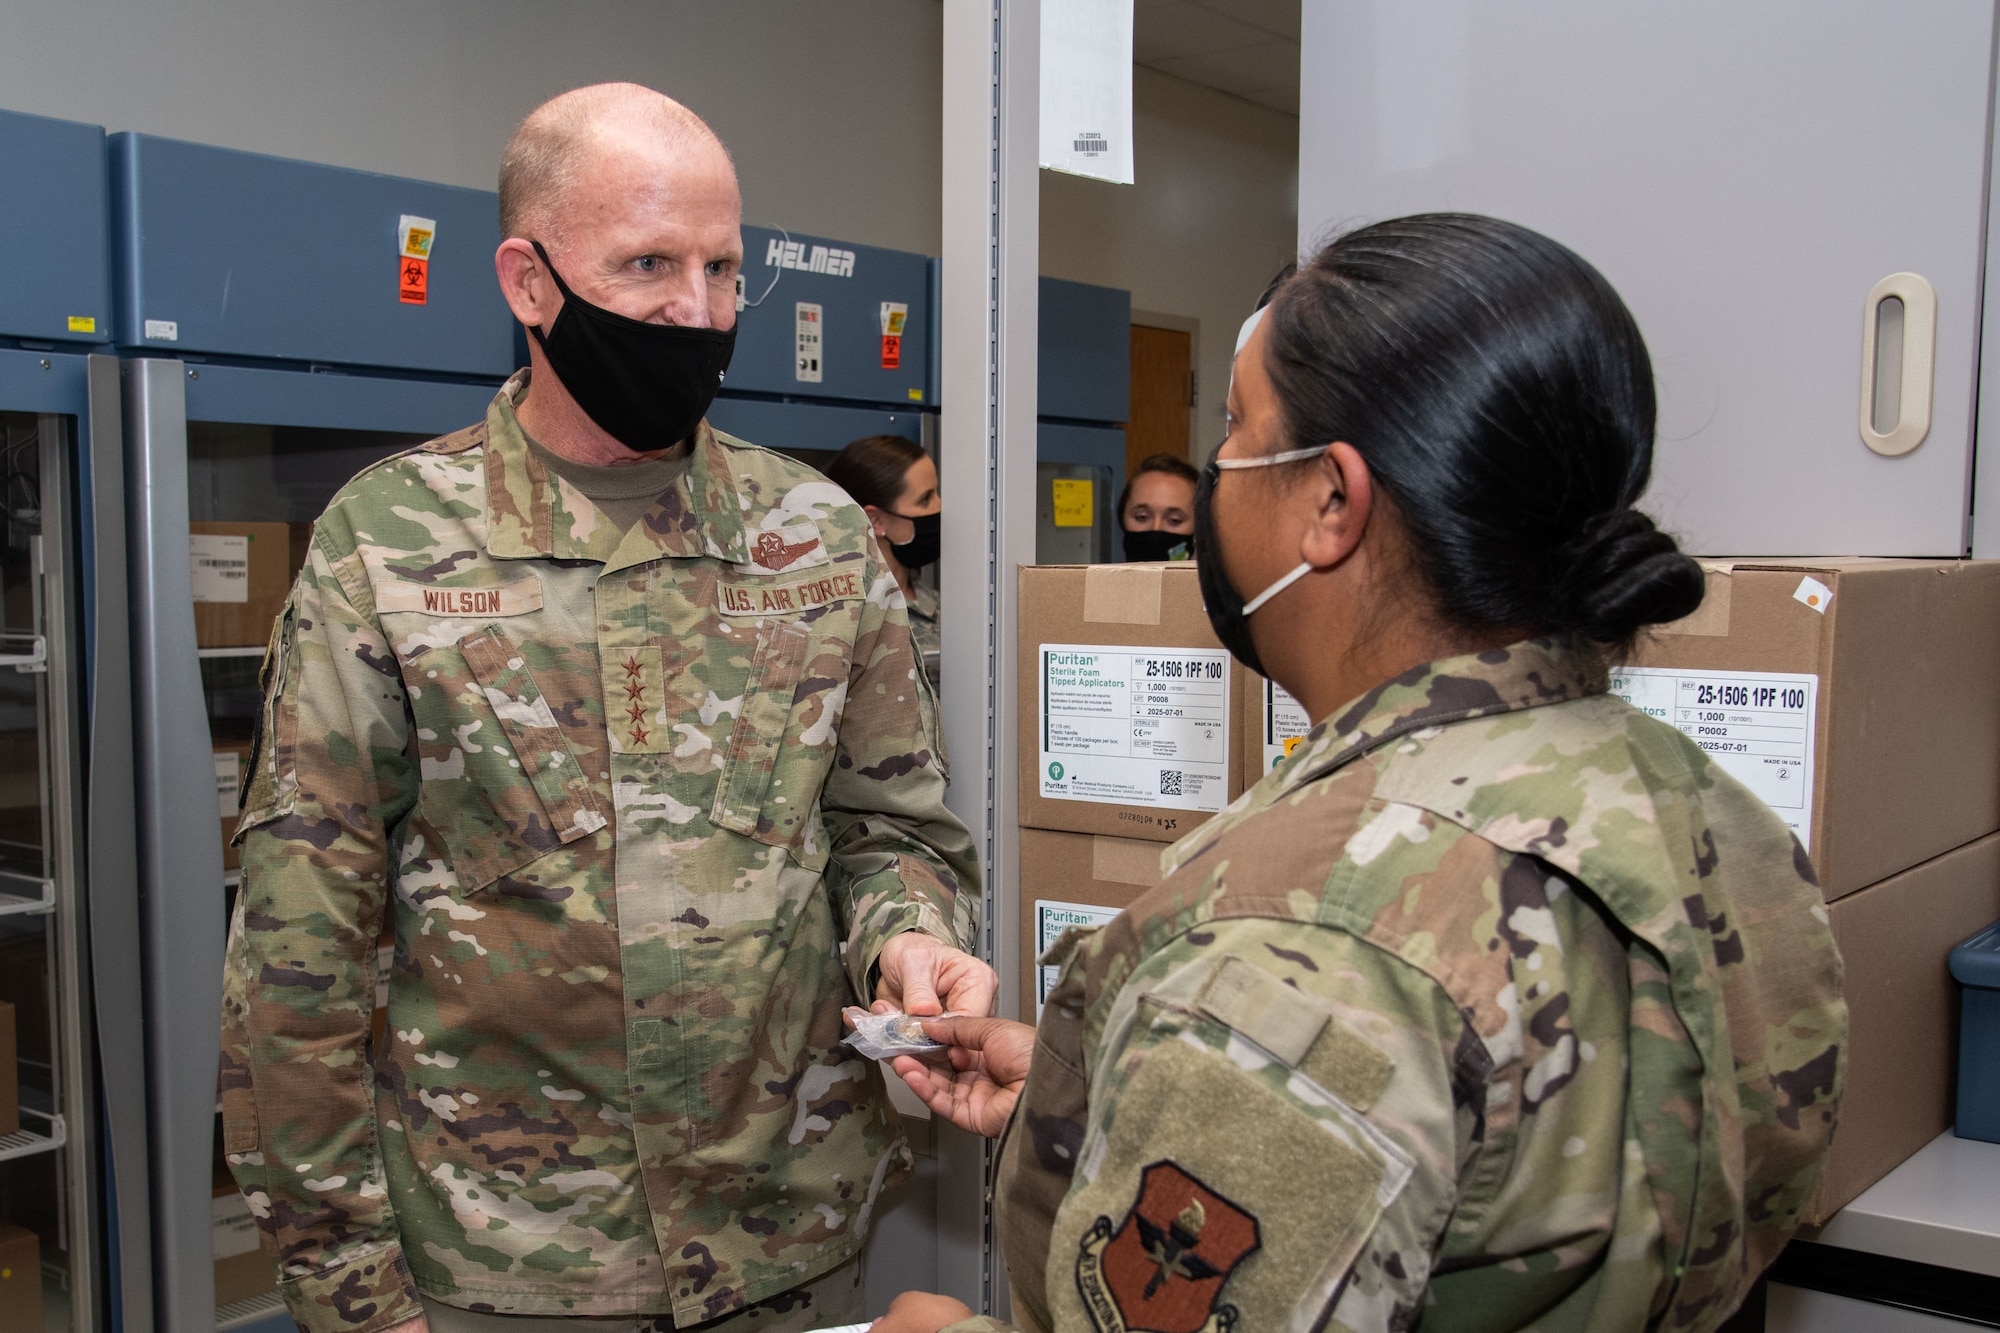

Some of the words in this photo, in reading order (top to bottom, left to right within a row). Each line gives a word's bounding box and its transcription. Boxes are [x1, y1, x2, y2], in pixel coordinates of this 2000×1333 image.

[765, 239, 855, 278] HELMER
[724, 587, 756, 611] U.S.
[762, 588, 794, 610] AIR
[797, 574, 858, 606] FORCE
[423, 590, 500, 612] WILSON
[1050, 667, 1076, 676] Sterile
[1078, 668, 1100, 677] Foam
[1146, 660, 1182, 677] 25-1506
[1185, 661, 1202, 678] 1PF
[1205, 662, 1222, 678] 100
[1050, 677, 1076, 687] Tipped
[1078, 678, 1125, 688] Applicators
[1147, 683, 1166, 692] 1,000
[1698, 685, 1748, 706] 25-1506
[1752, 688, 1776, 707] 1PF
[1781, 688, 1804, 708] 100
[1148, 708, 1183, 716] 2025-07-01
[1698, 712, 1724, 722] 1,000
[1698, 726, 1728, 736] P0002
[1698, 742, 1748, 752] 2025-07-01
[1780, 769, 1786, 778] 2
